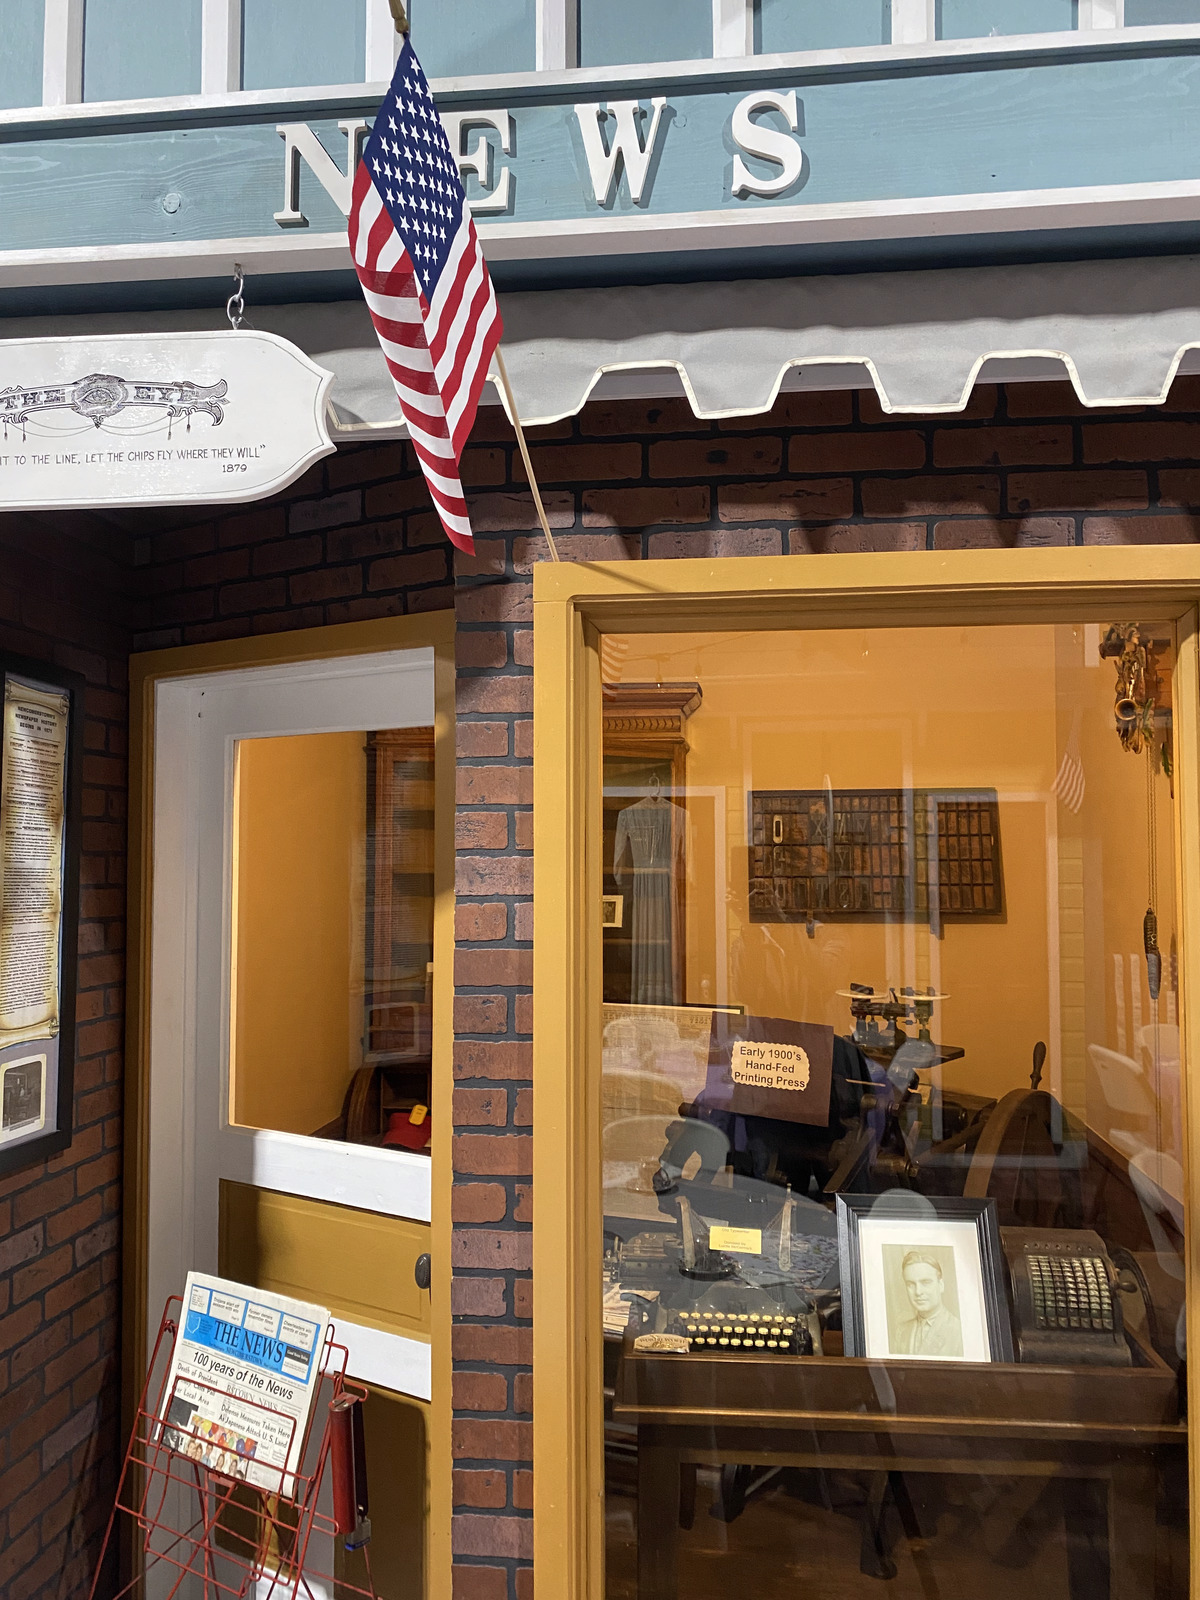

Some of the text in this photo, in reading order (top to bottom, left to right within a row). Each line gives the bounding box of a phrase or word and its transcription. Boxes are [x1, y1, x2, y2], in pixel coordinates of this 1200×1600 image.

[273, 90, 804, 223] NEWS
[14, 455, 27, 465] TO
[32, 454, 51, 465] THE
[56, 453, 81, 465] LINE,
[85, 452, 104, 463] LET
[108, 451, 124, 462] THE
[128, 450, 155, 461] CHIPS
[157, 449, 173, 460] FLY
[177, 448, 208, 459] WHERE
[211, 447, 234, 458] THEY
[222, 463, 248, 473] 1879
[740, 1046, 765, 1059] Early
[745, 1060, 795, 1073] Hand-Fed
[734, 1072, 805, 1088] Printing Press
[213, 1320, 242, 1347] THE
[241, 1330, 284, 1363] NEWS
[193, 1351, 209, 1366] 100
[208, 1360, 235, 1377] years
[235, 1370, 249, 1382] of
[248, 1373, 264, 1388] the
[265, 1380, 293, 1400] News
[220, 1403, 239, 1417] Defense
[262, 1421, 276, 1433] Taken
[278, 1428, 290, 1439] Here
[274, 1437, 288, 1449] Land
